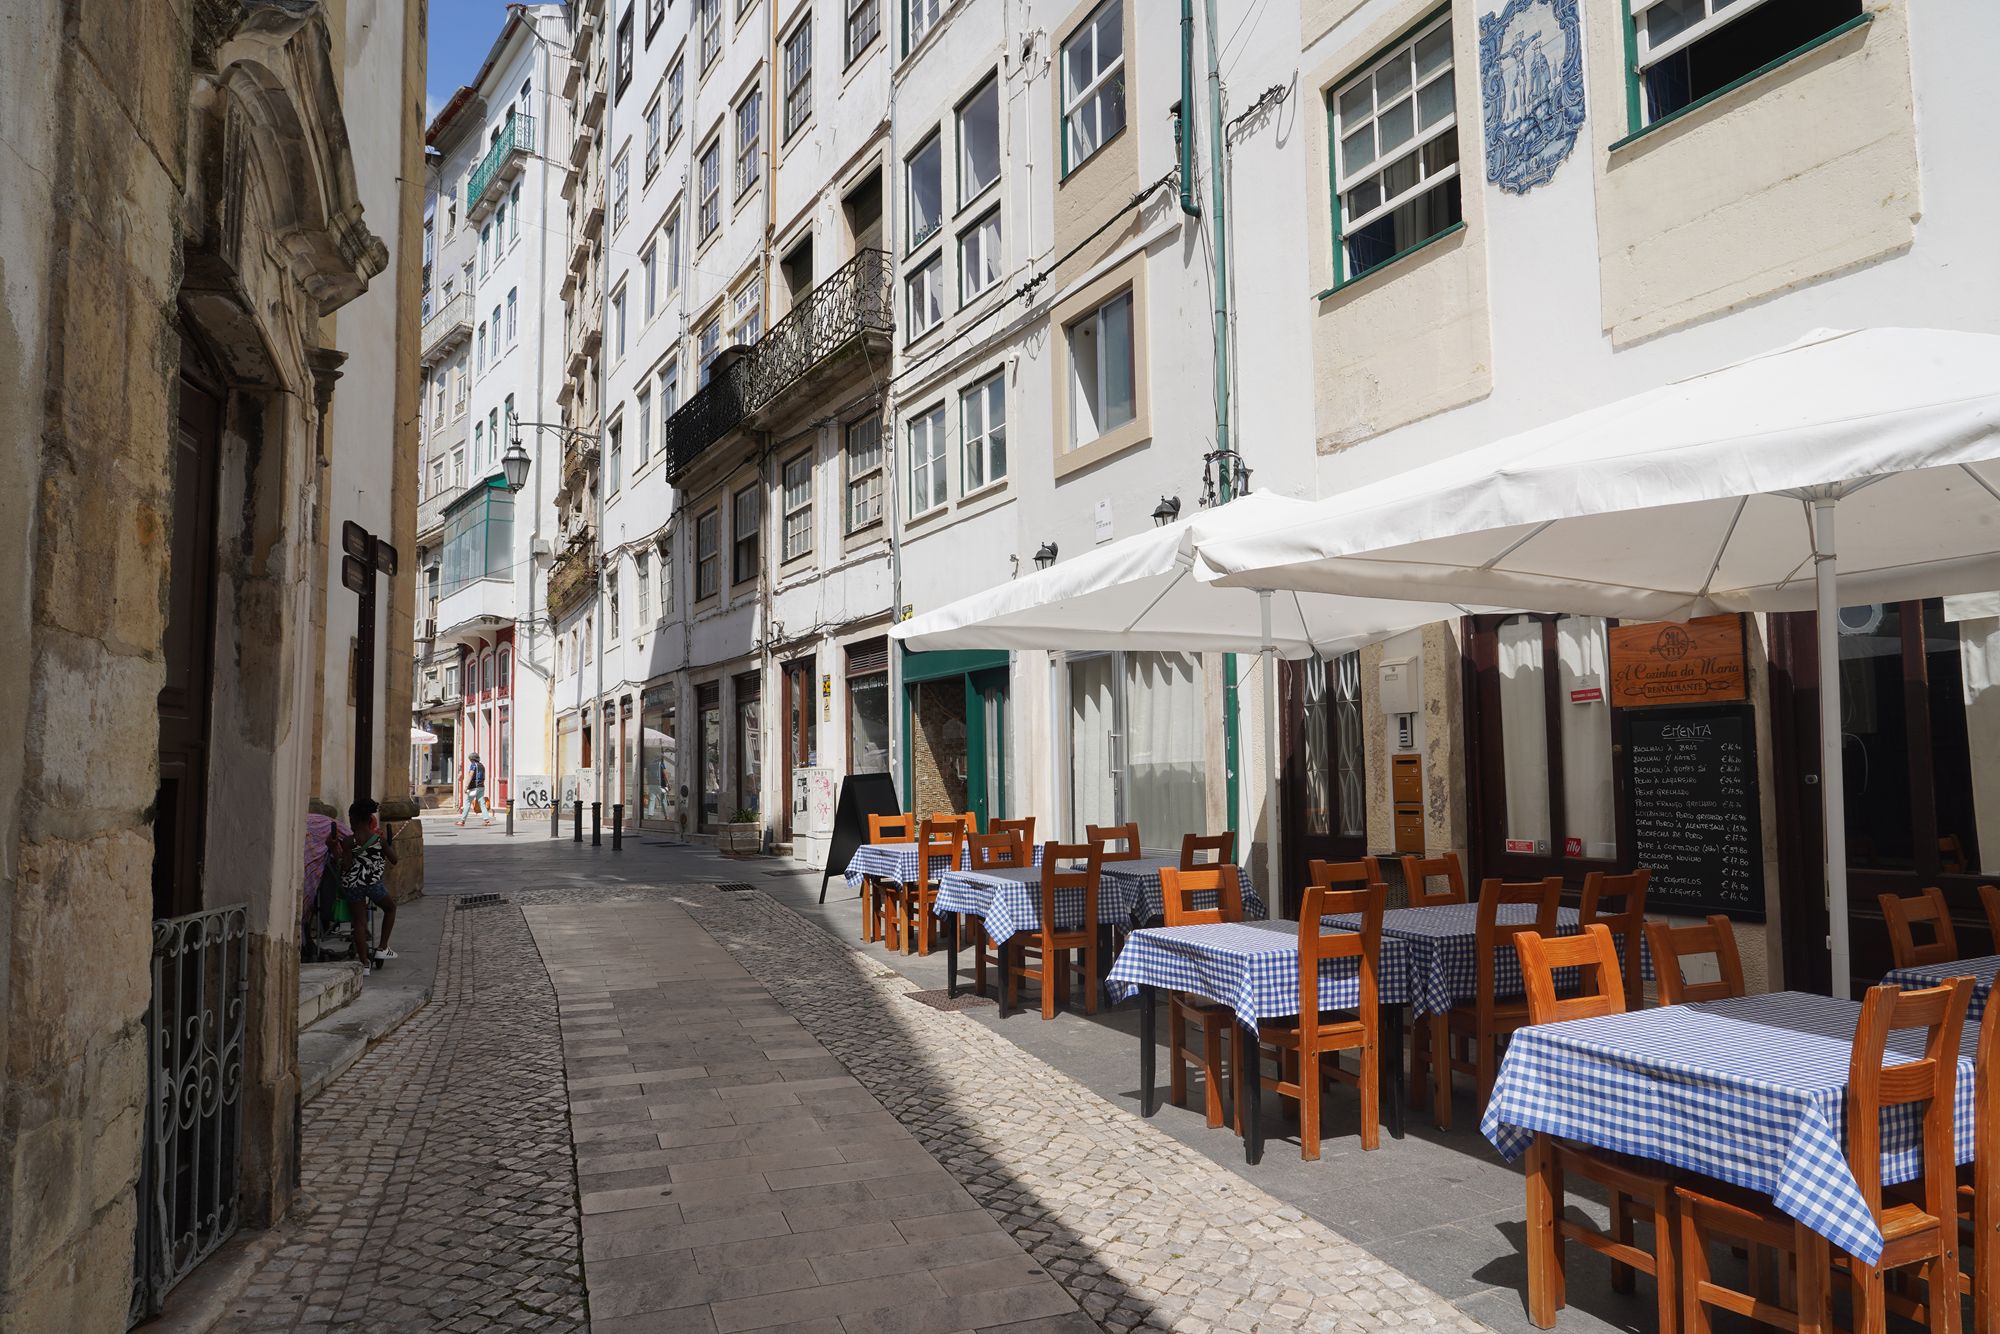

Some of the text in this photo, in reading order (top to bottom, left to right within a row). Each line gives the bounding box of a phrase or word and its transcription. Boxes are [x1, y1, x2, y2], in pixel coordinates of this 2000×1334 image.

[1615, 656, 1739, 682] A Cozinha da Maria
[1647, 682, 1705, 694] RESTAURANTE
[1661, 722, 1712, 738] EMENTA
[1674, 753, 1697, 761] NATAS
[1634, 787, 1654, 796] PEIXE
[1656, 788, 1690, 797] GRELHADO
[1635, 799, 1654, 807] PEITO
[1686, 800, 1717, 808] GRELHADO
[1675, 811, 1694, 819] PORCO
[1656, 820, 1674, 828] PORCO
[1685, 832, 1704, 840] PORCO
[1566, 840, 1581, 855] illy
[1637, 841, 1654, 850] BIFE
[1676, 855, 1702, 863] NOVILHO
